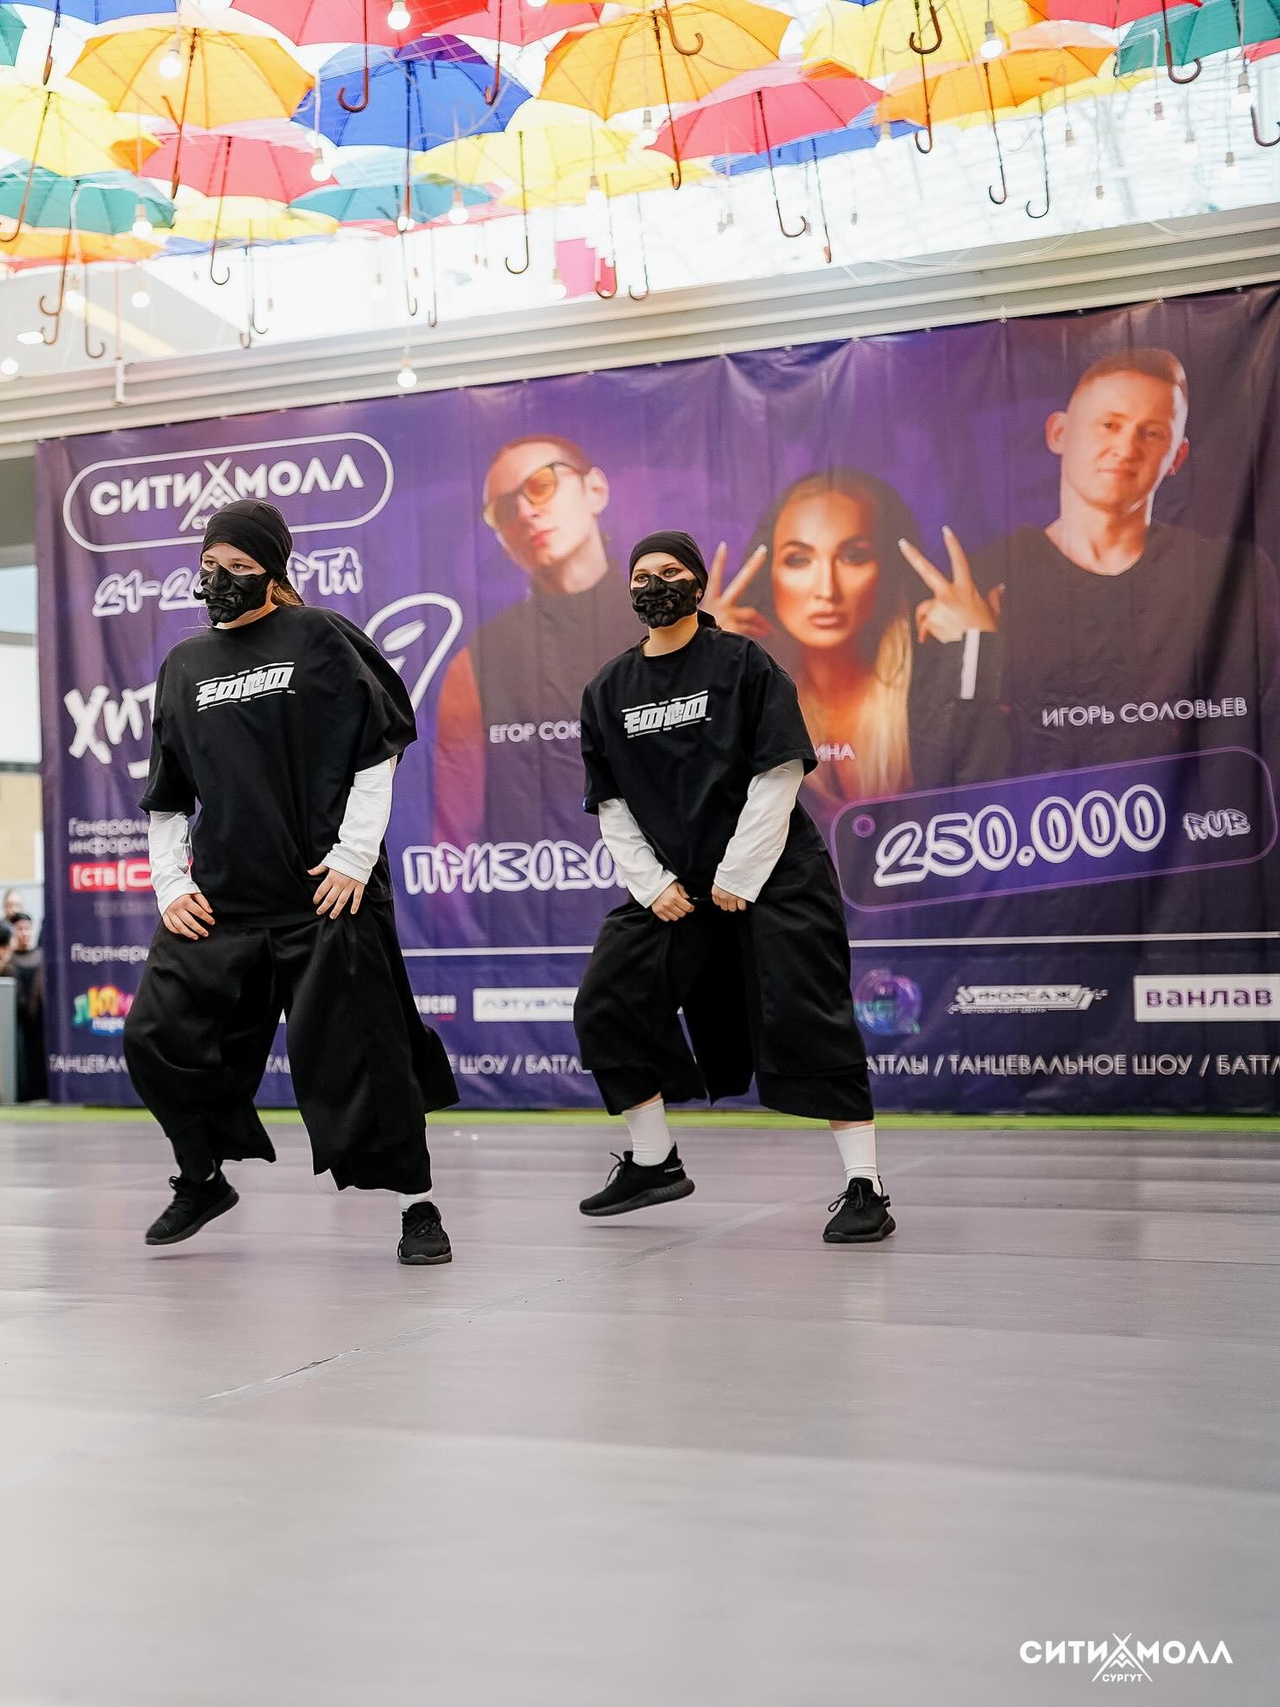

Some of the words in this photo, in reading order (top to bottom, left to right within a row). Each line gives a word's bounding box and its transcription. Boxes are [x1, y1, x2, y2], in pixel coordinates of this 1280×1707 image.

[1041, 704, 1115, 727] ИГОРЬ
[1120, 696, 1248, 723] СОЛОВЬЕВ
[489, 722, 537, 744] ЕГОР
[874, 783, 1166, 887] 250.000
[1183, 808, 1251, 840] RUB
[1145, 987, 1273, 1008] ванлав
[459, 1054, 509, 1075] ШОУ
[525, 1054, 593, 1075] БАТТЛ
[947, 1053, 1127, 1077] ТАНЦЕВАЛЬНОЕ
[1131, 1053, 1193, 1076] ШОУ
